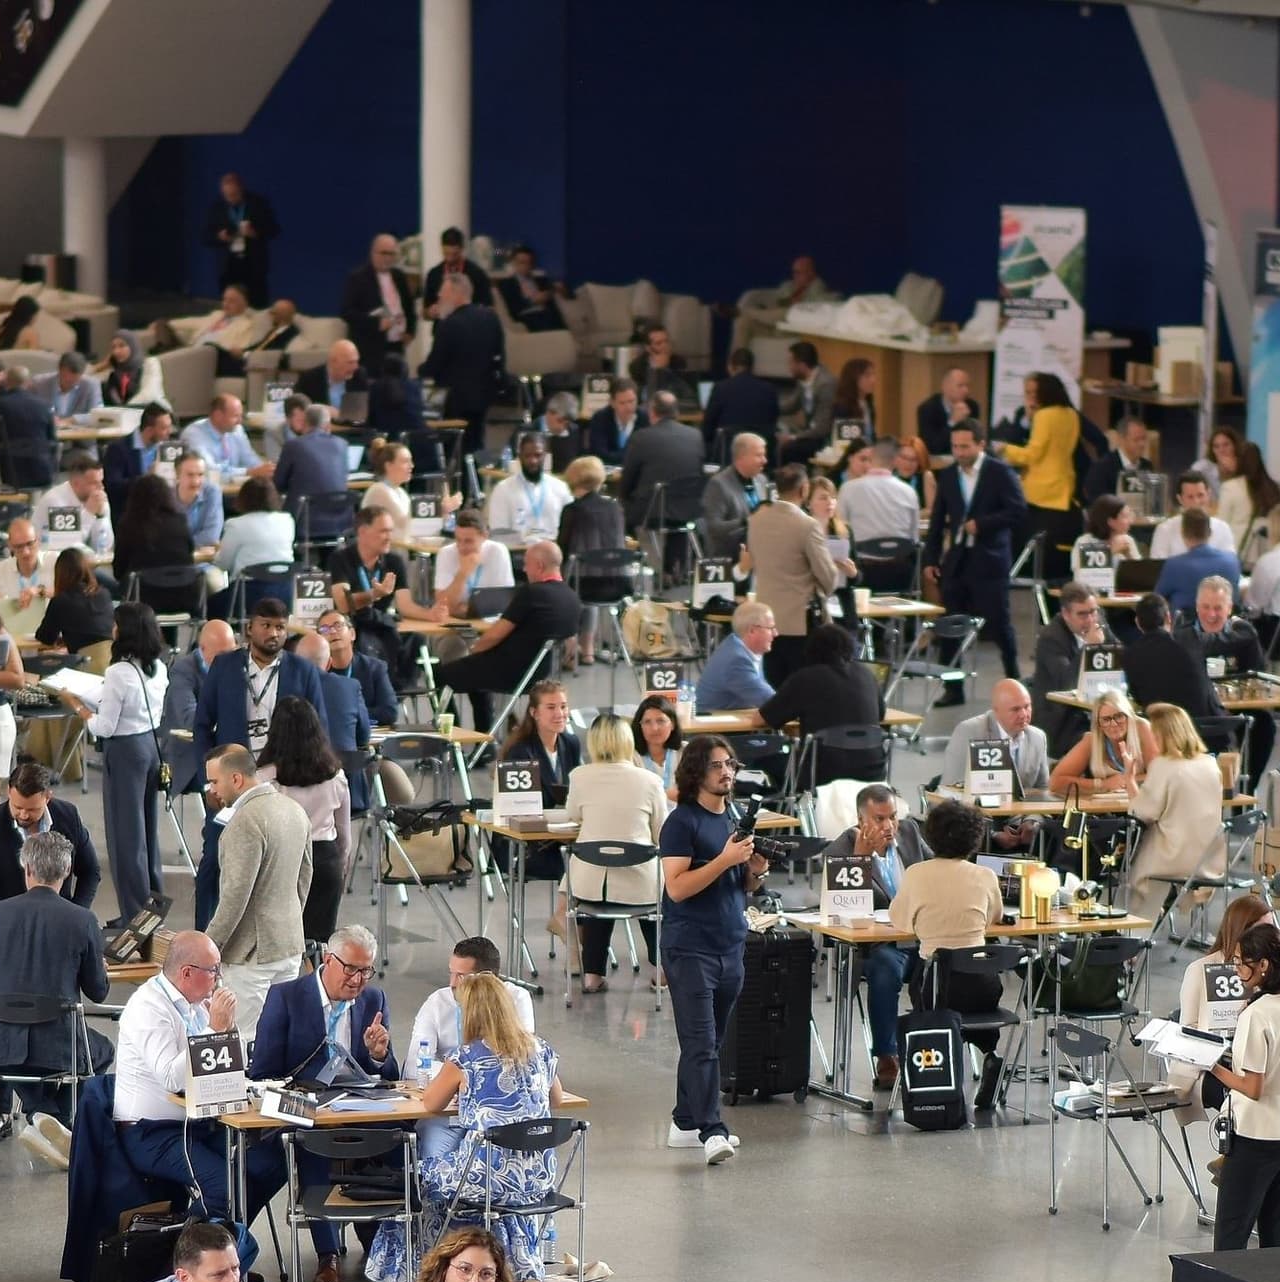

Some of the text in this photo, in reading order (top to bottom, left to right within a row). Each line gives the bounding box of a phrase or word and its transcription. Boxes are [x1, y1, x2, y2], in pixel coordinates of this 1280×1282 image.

[417, 502, 436, 517] 81
[55, 515, 77, 529] 82
[1086, 551, 1107, 567] 70
[705, 566, 725, 581] 71
[303, 580, 326, 597] 72
[1093, 652, 1113, 669] 61
[652, 670, 677, 689] 62
[978, 748, 1003, 767] 52
[506, 771, 533, 790] 53
[836, 866, 864, 887] 43
[1215, 975, 1244, 998] 33
[200, 1046, 233, 1071] 34
